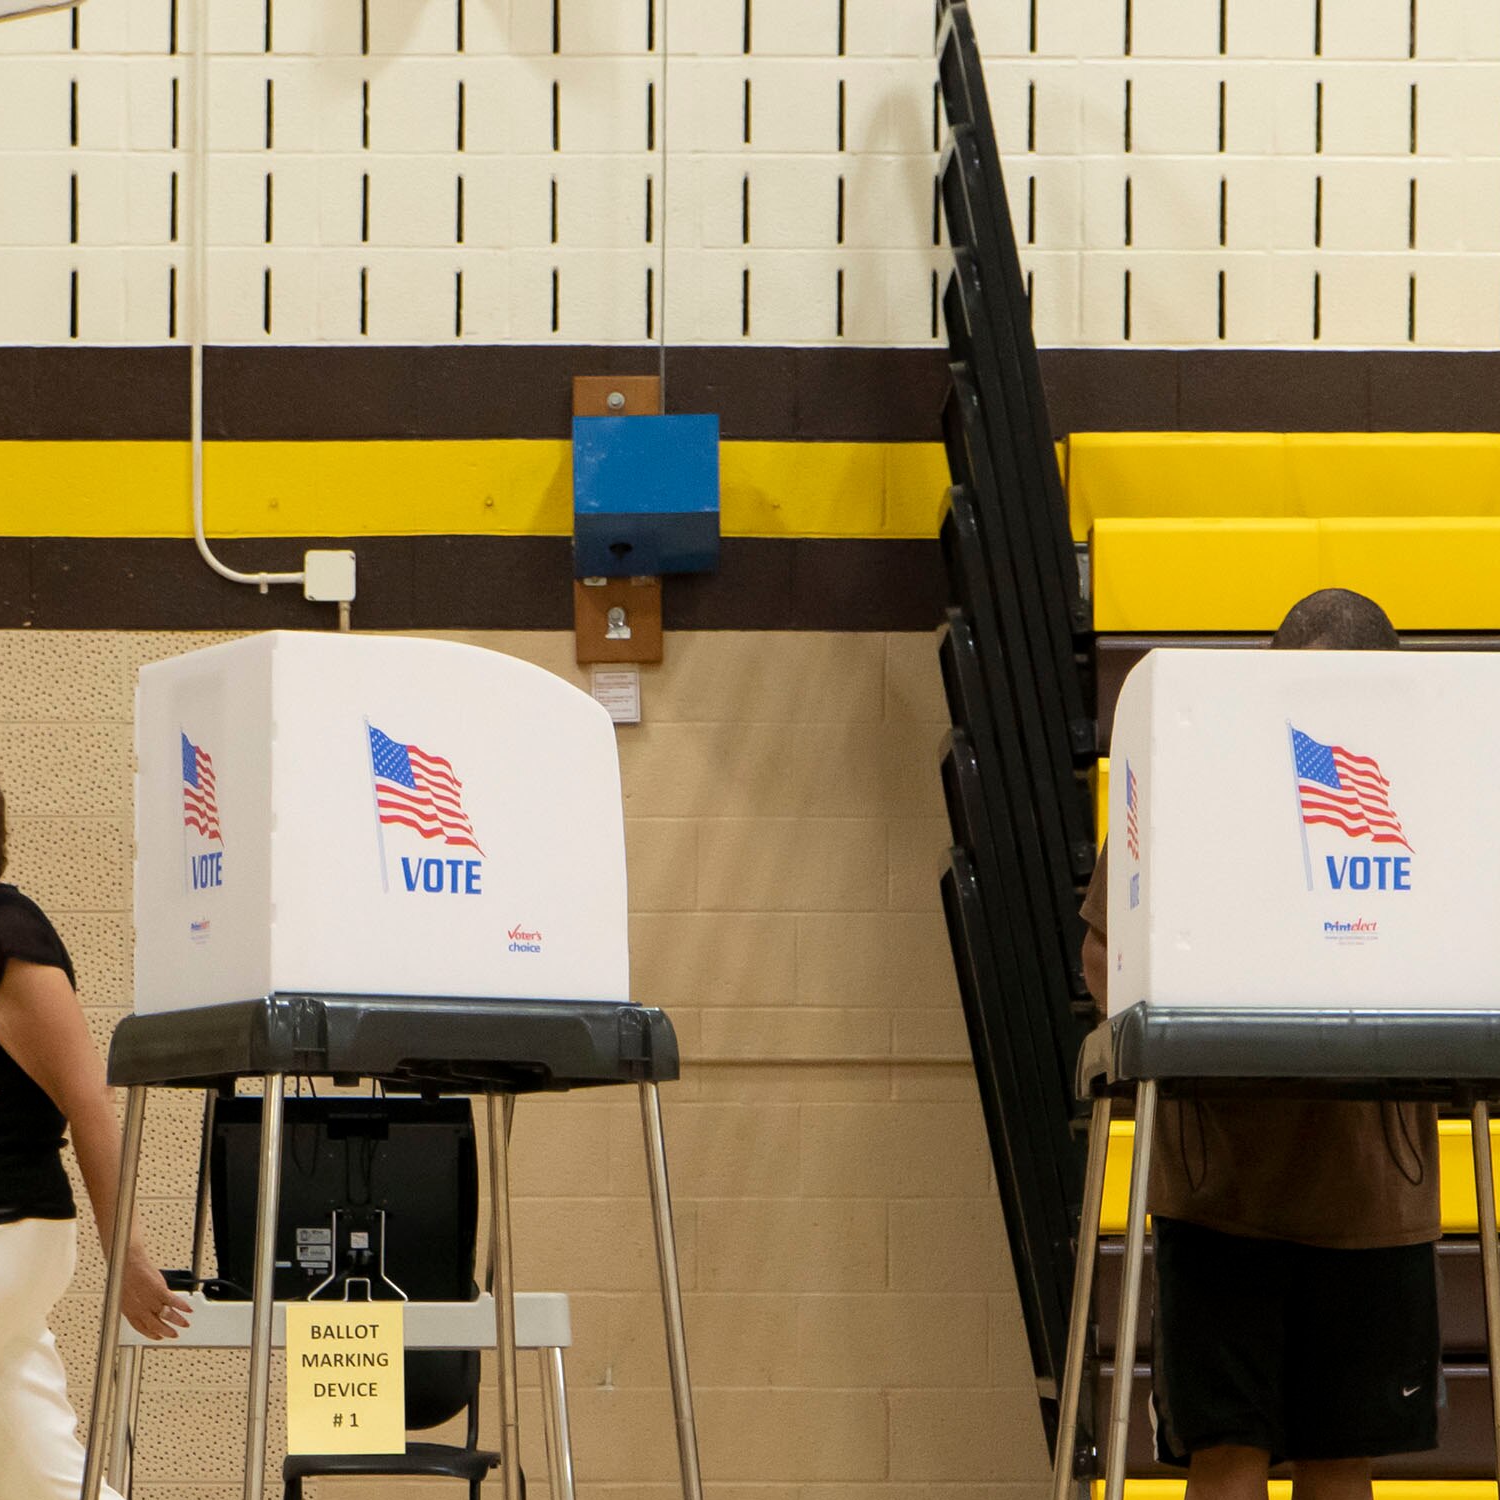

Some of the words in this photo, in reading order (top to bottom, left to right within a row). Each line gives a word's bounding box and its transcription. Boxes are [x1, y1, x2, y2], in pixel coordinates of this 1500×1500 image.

[192, 851, 222, 890] VOTE
[401, 857, 482, 895] VOTE
[1326, 855, 1411, 890] VOTE
[508, 924, 542, 941] Voter's
[508, 942, 541, 953] choice
[311, 1324, 379, 1340] BALLOT
[302, 1353, 389, 1368] MARKING
[314, 1382, 378, 1397] DEVICE
[350, 1413, 359, 1428] 1
